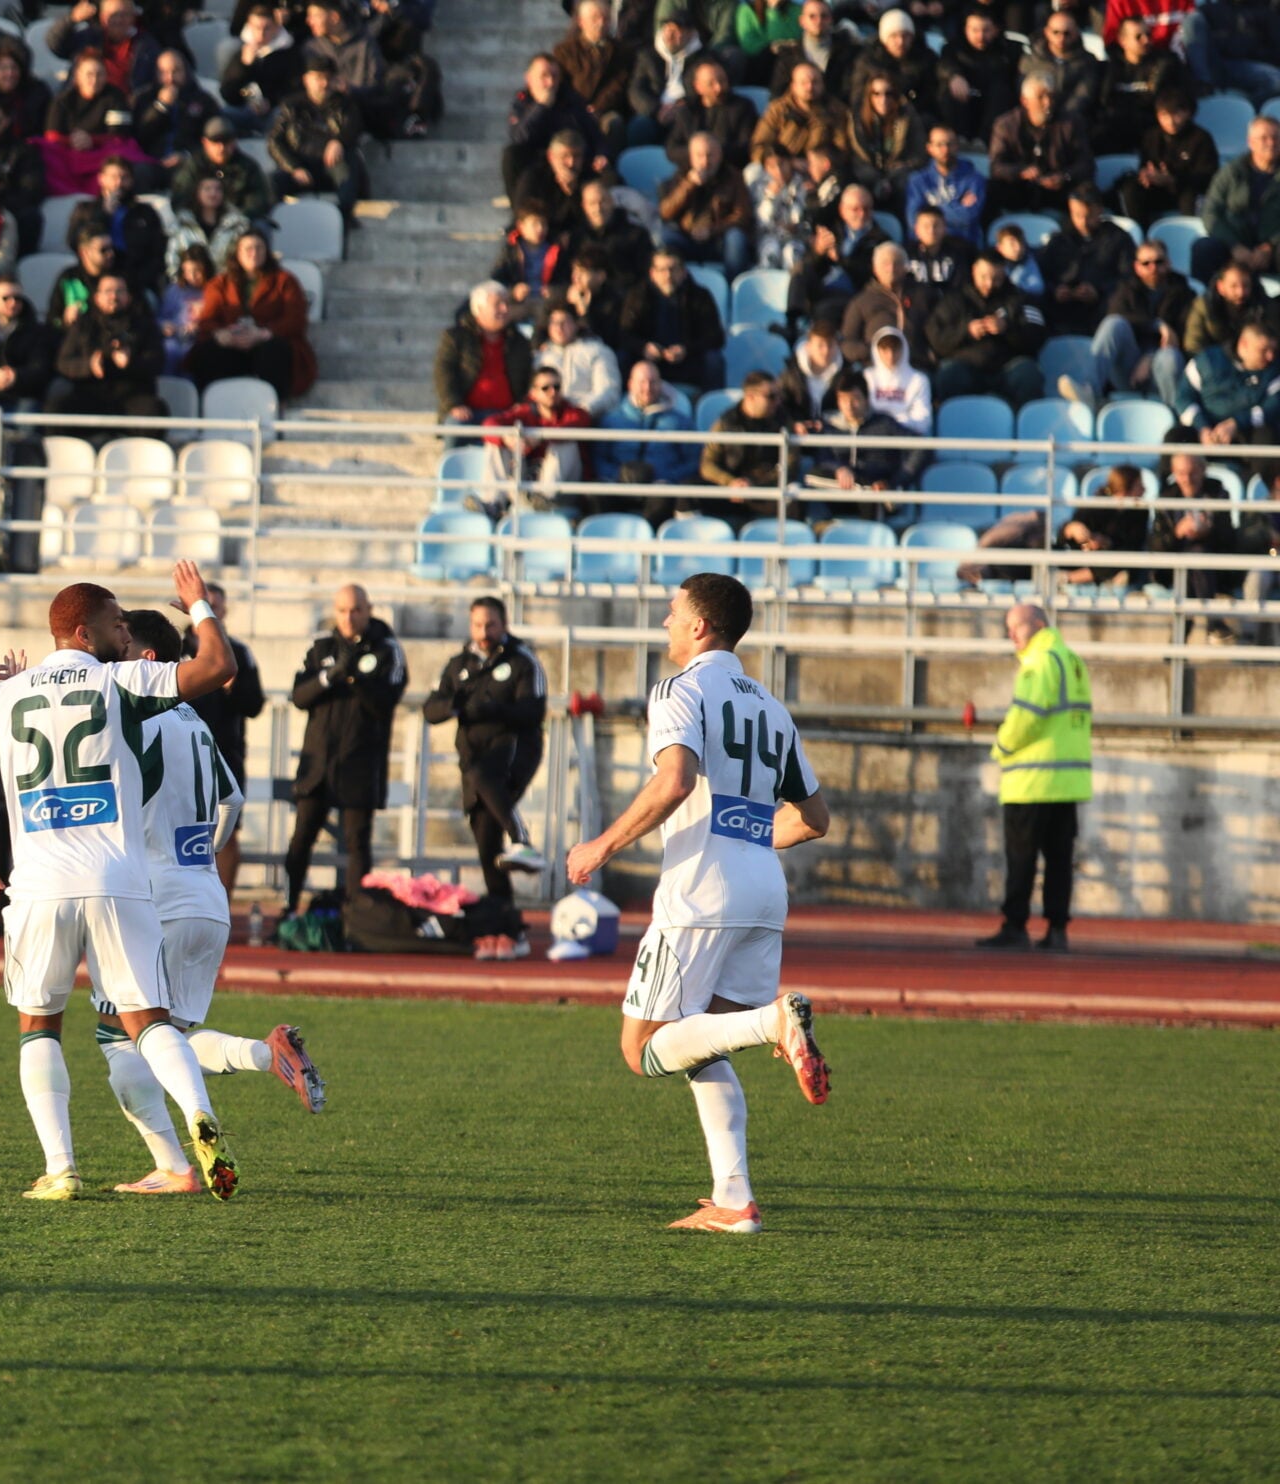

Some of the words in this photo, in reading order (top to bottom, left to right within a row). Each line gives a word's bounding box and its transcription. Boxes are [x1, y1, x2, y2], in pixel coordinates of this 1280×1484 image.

[31, 668, 88, 688] VILHENA
[10, 690, 112, 791] 52
[190, 730, 217, 823] 17
[722, 700, 784, 802] 44
